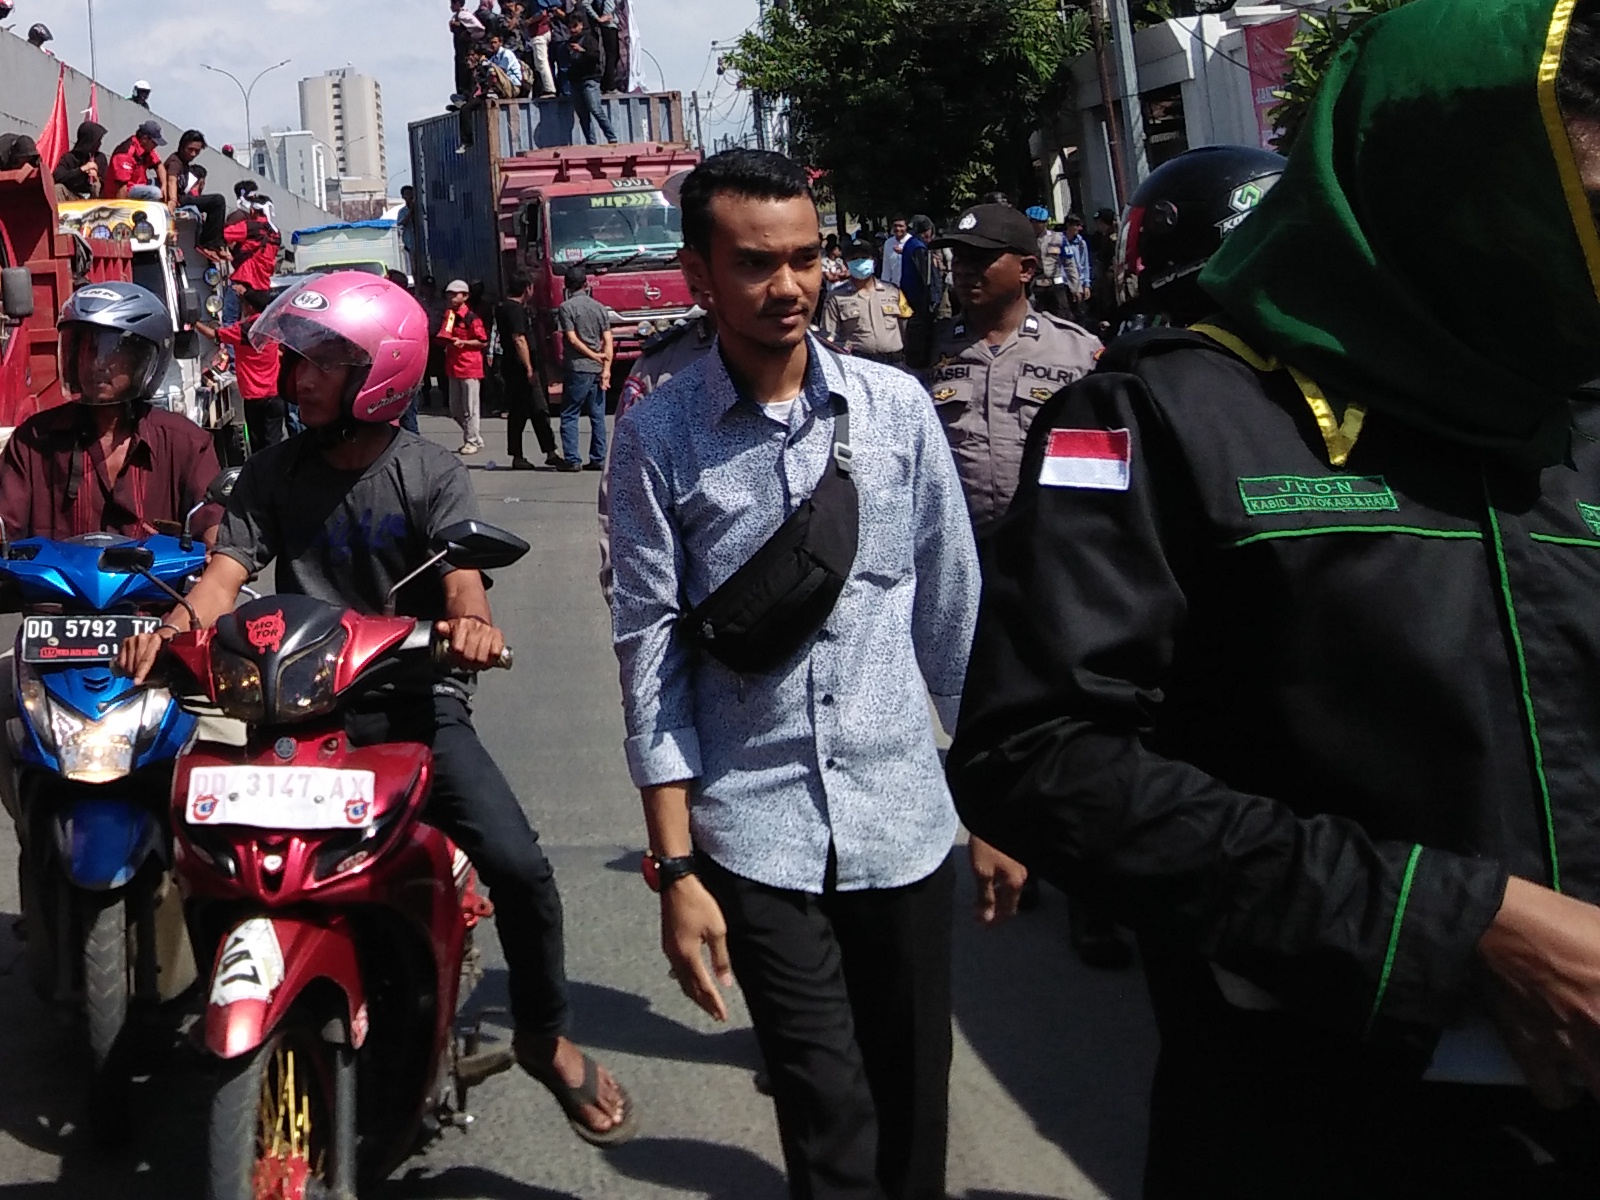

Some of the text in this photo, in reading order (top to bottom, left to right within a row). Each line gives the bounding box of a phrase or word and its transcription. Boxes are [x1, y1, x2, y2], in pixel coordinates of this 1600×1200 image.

[1021, 363, 1074, 384] POLRI
[27, 619, 158, 639] DD 5792 TK
[194, 772, 367, 801] DD 3147 AX
